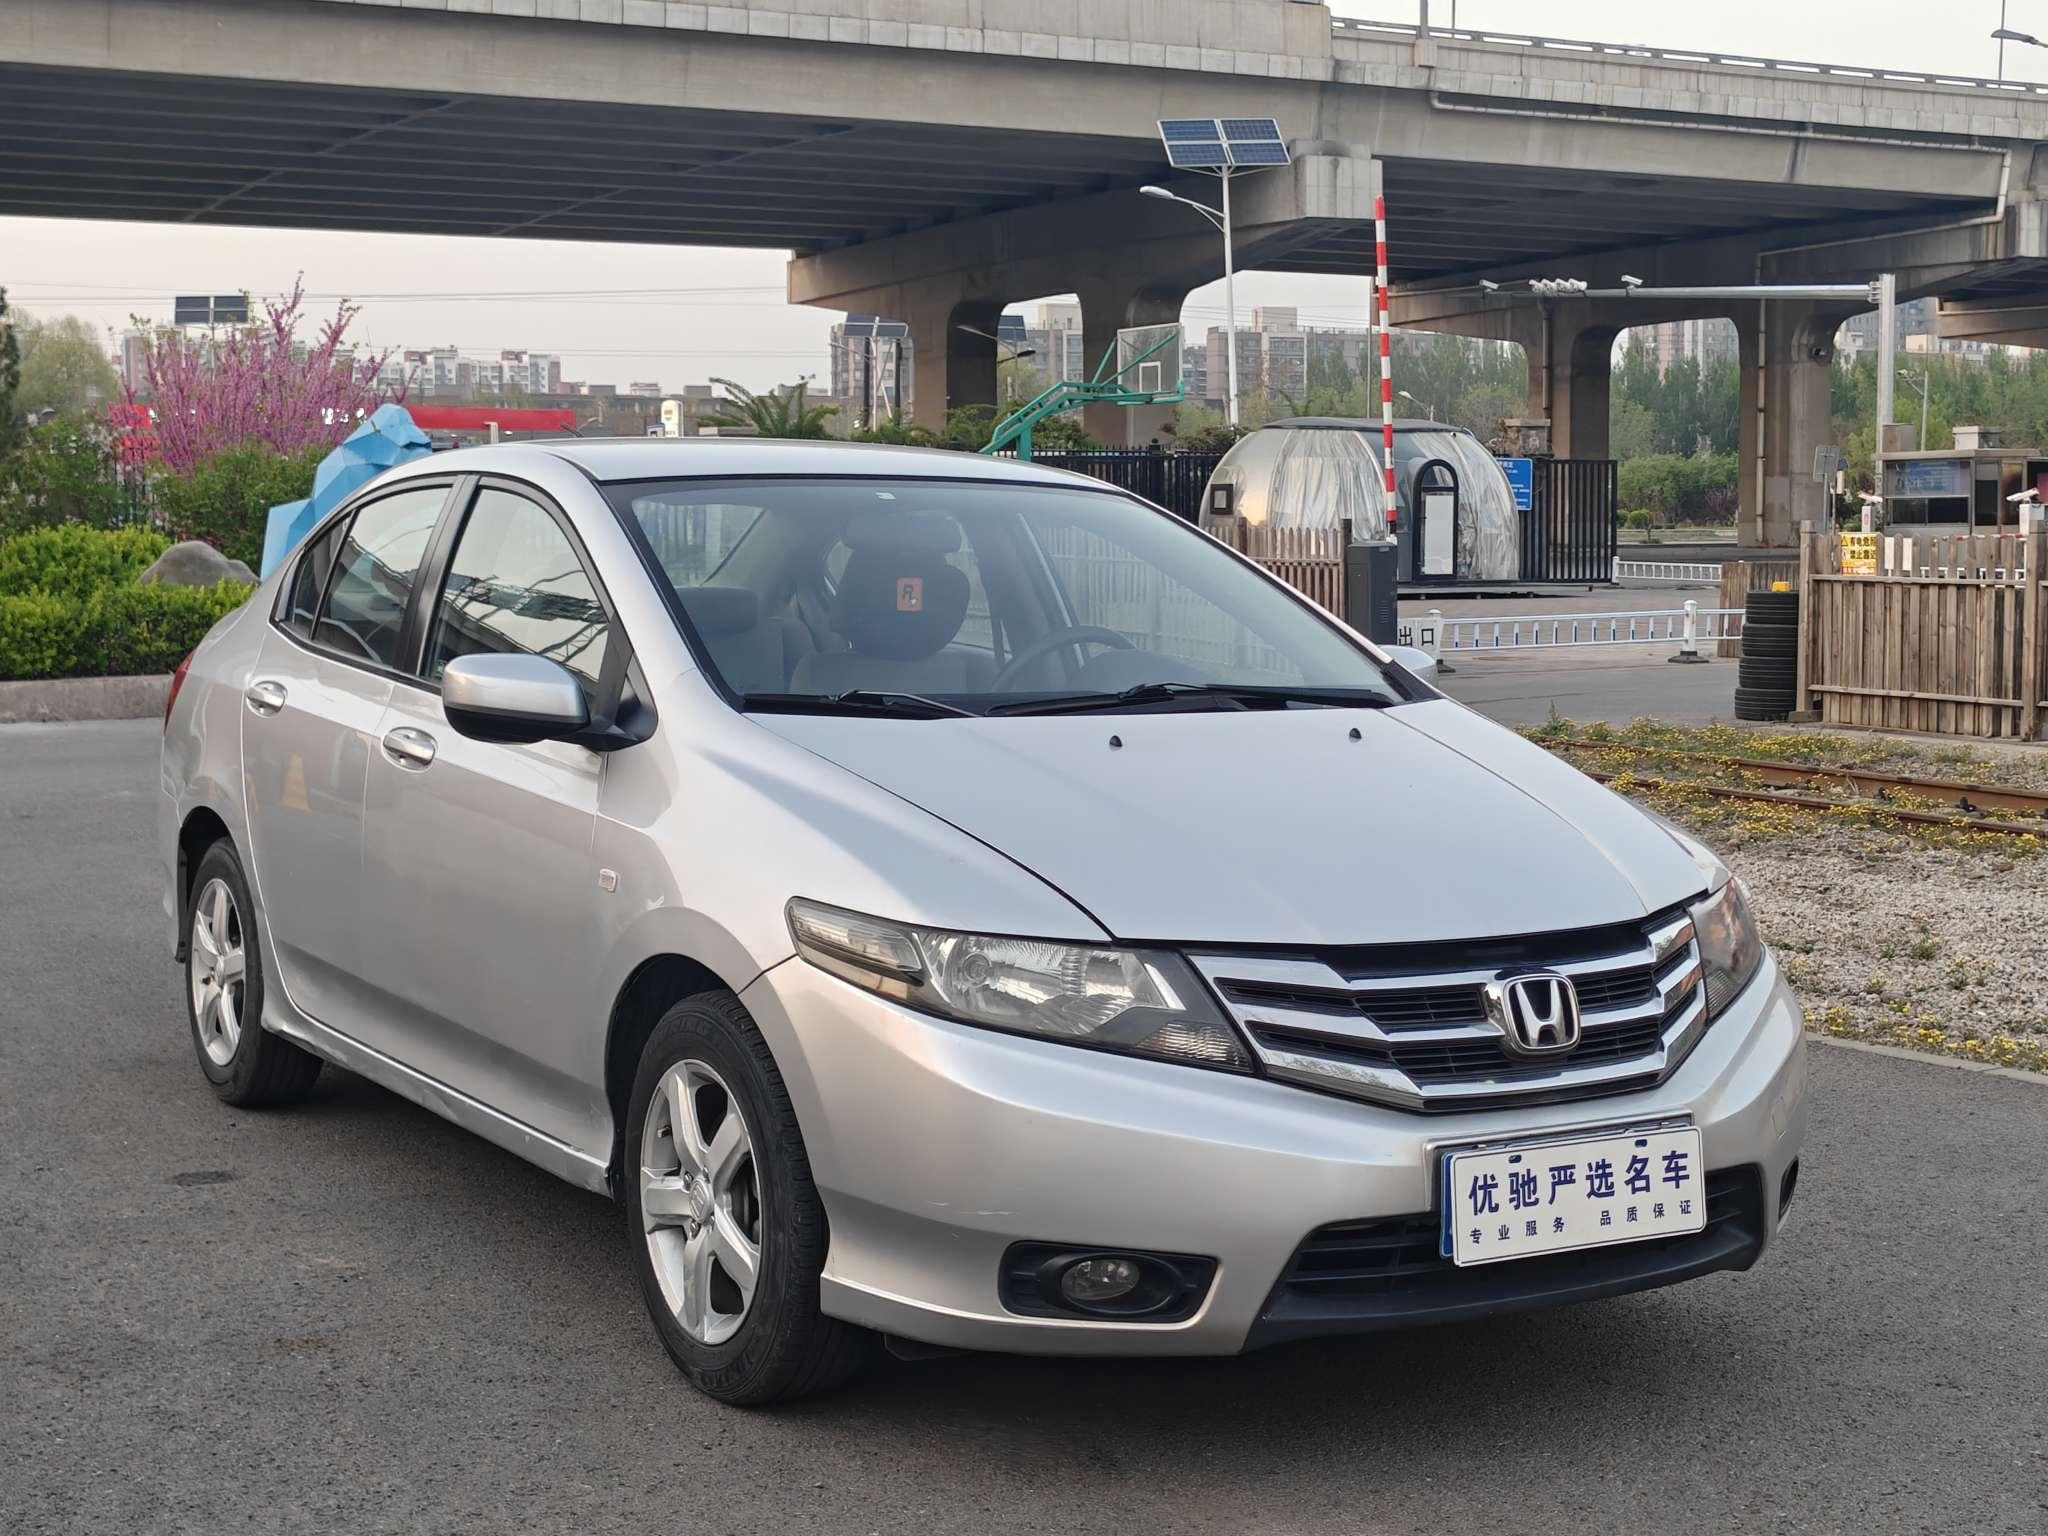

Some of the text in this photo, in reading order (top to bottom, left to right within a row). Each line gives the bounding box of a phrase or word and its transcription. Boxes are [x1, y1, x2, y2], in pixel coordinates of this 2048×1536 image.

[1399, 625, 1434, 647] 出口
[1468, 1150, 1691, 1216] 优驰严选名车
[1470, 1200, 1692, 1245] 专业服务 品质保证
